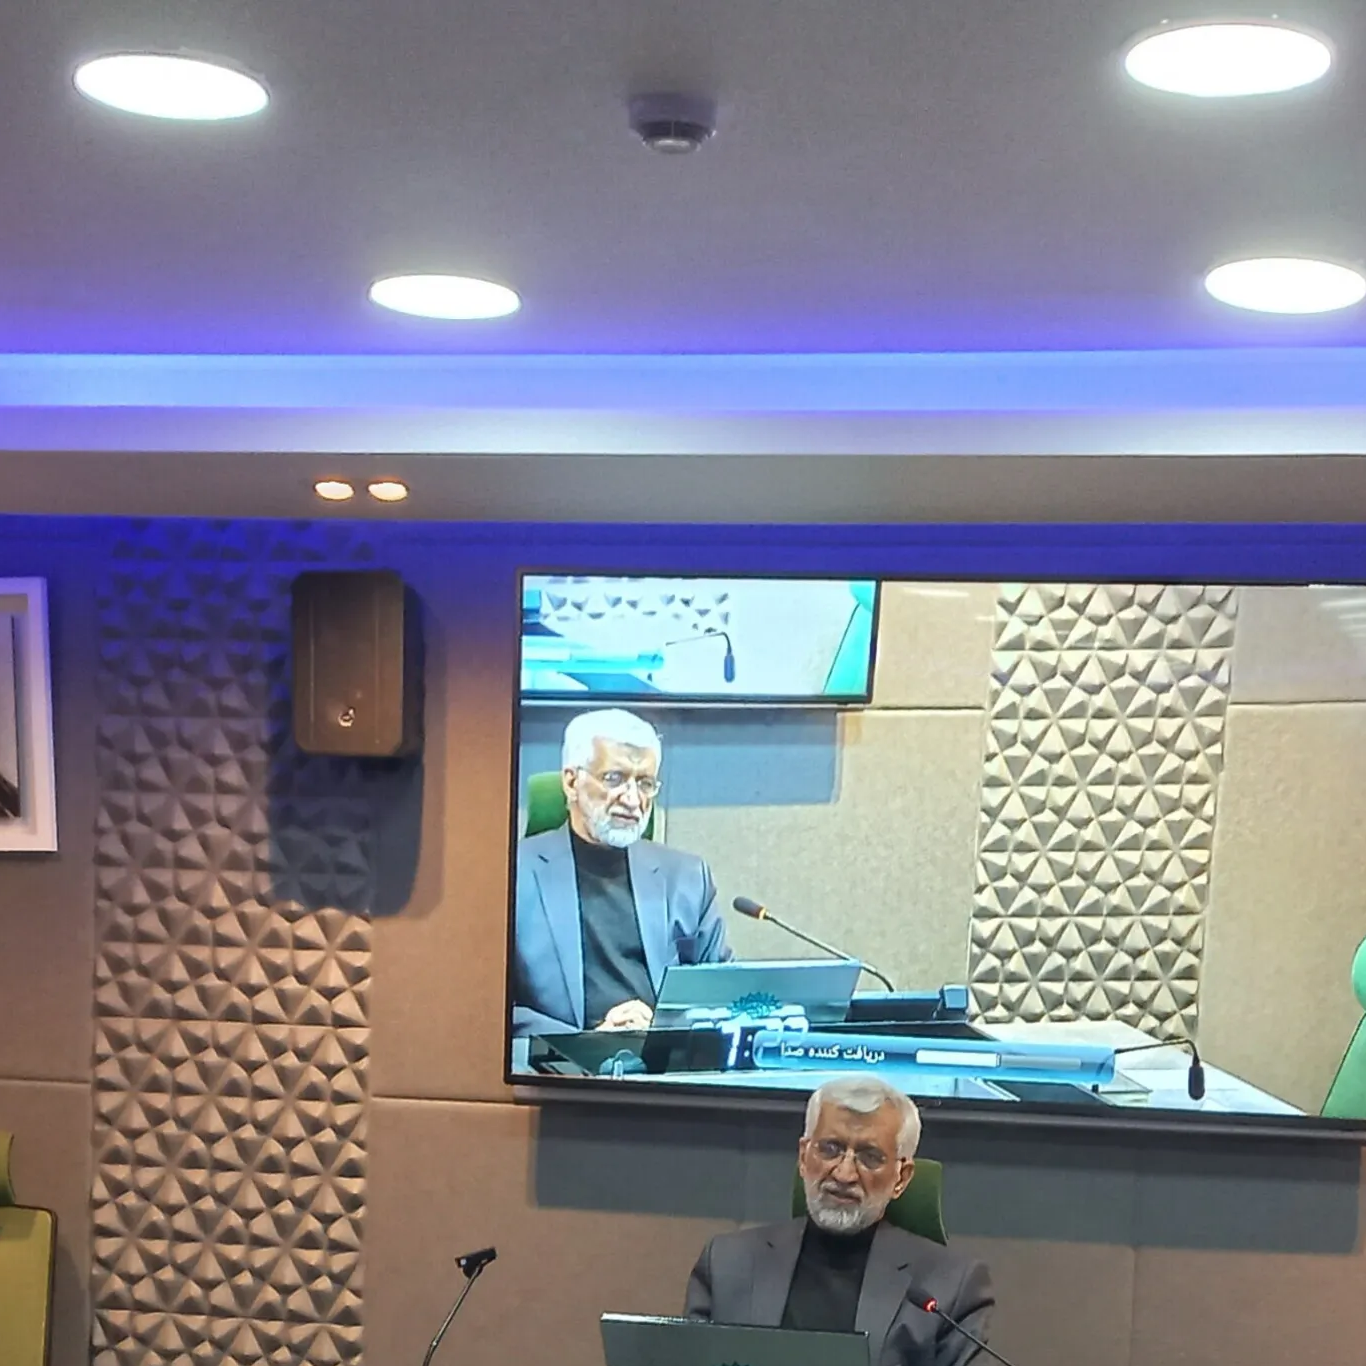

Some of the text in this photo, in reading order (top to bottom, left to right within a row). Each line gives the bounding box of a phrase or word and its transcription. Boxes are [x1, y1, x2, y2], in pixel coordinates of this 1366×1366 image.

[781, 1041, 885, 1063] دریافت کننده صدا
